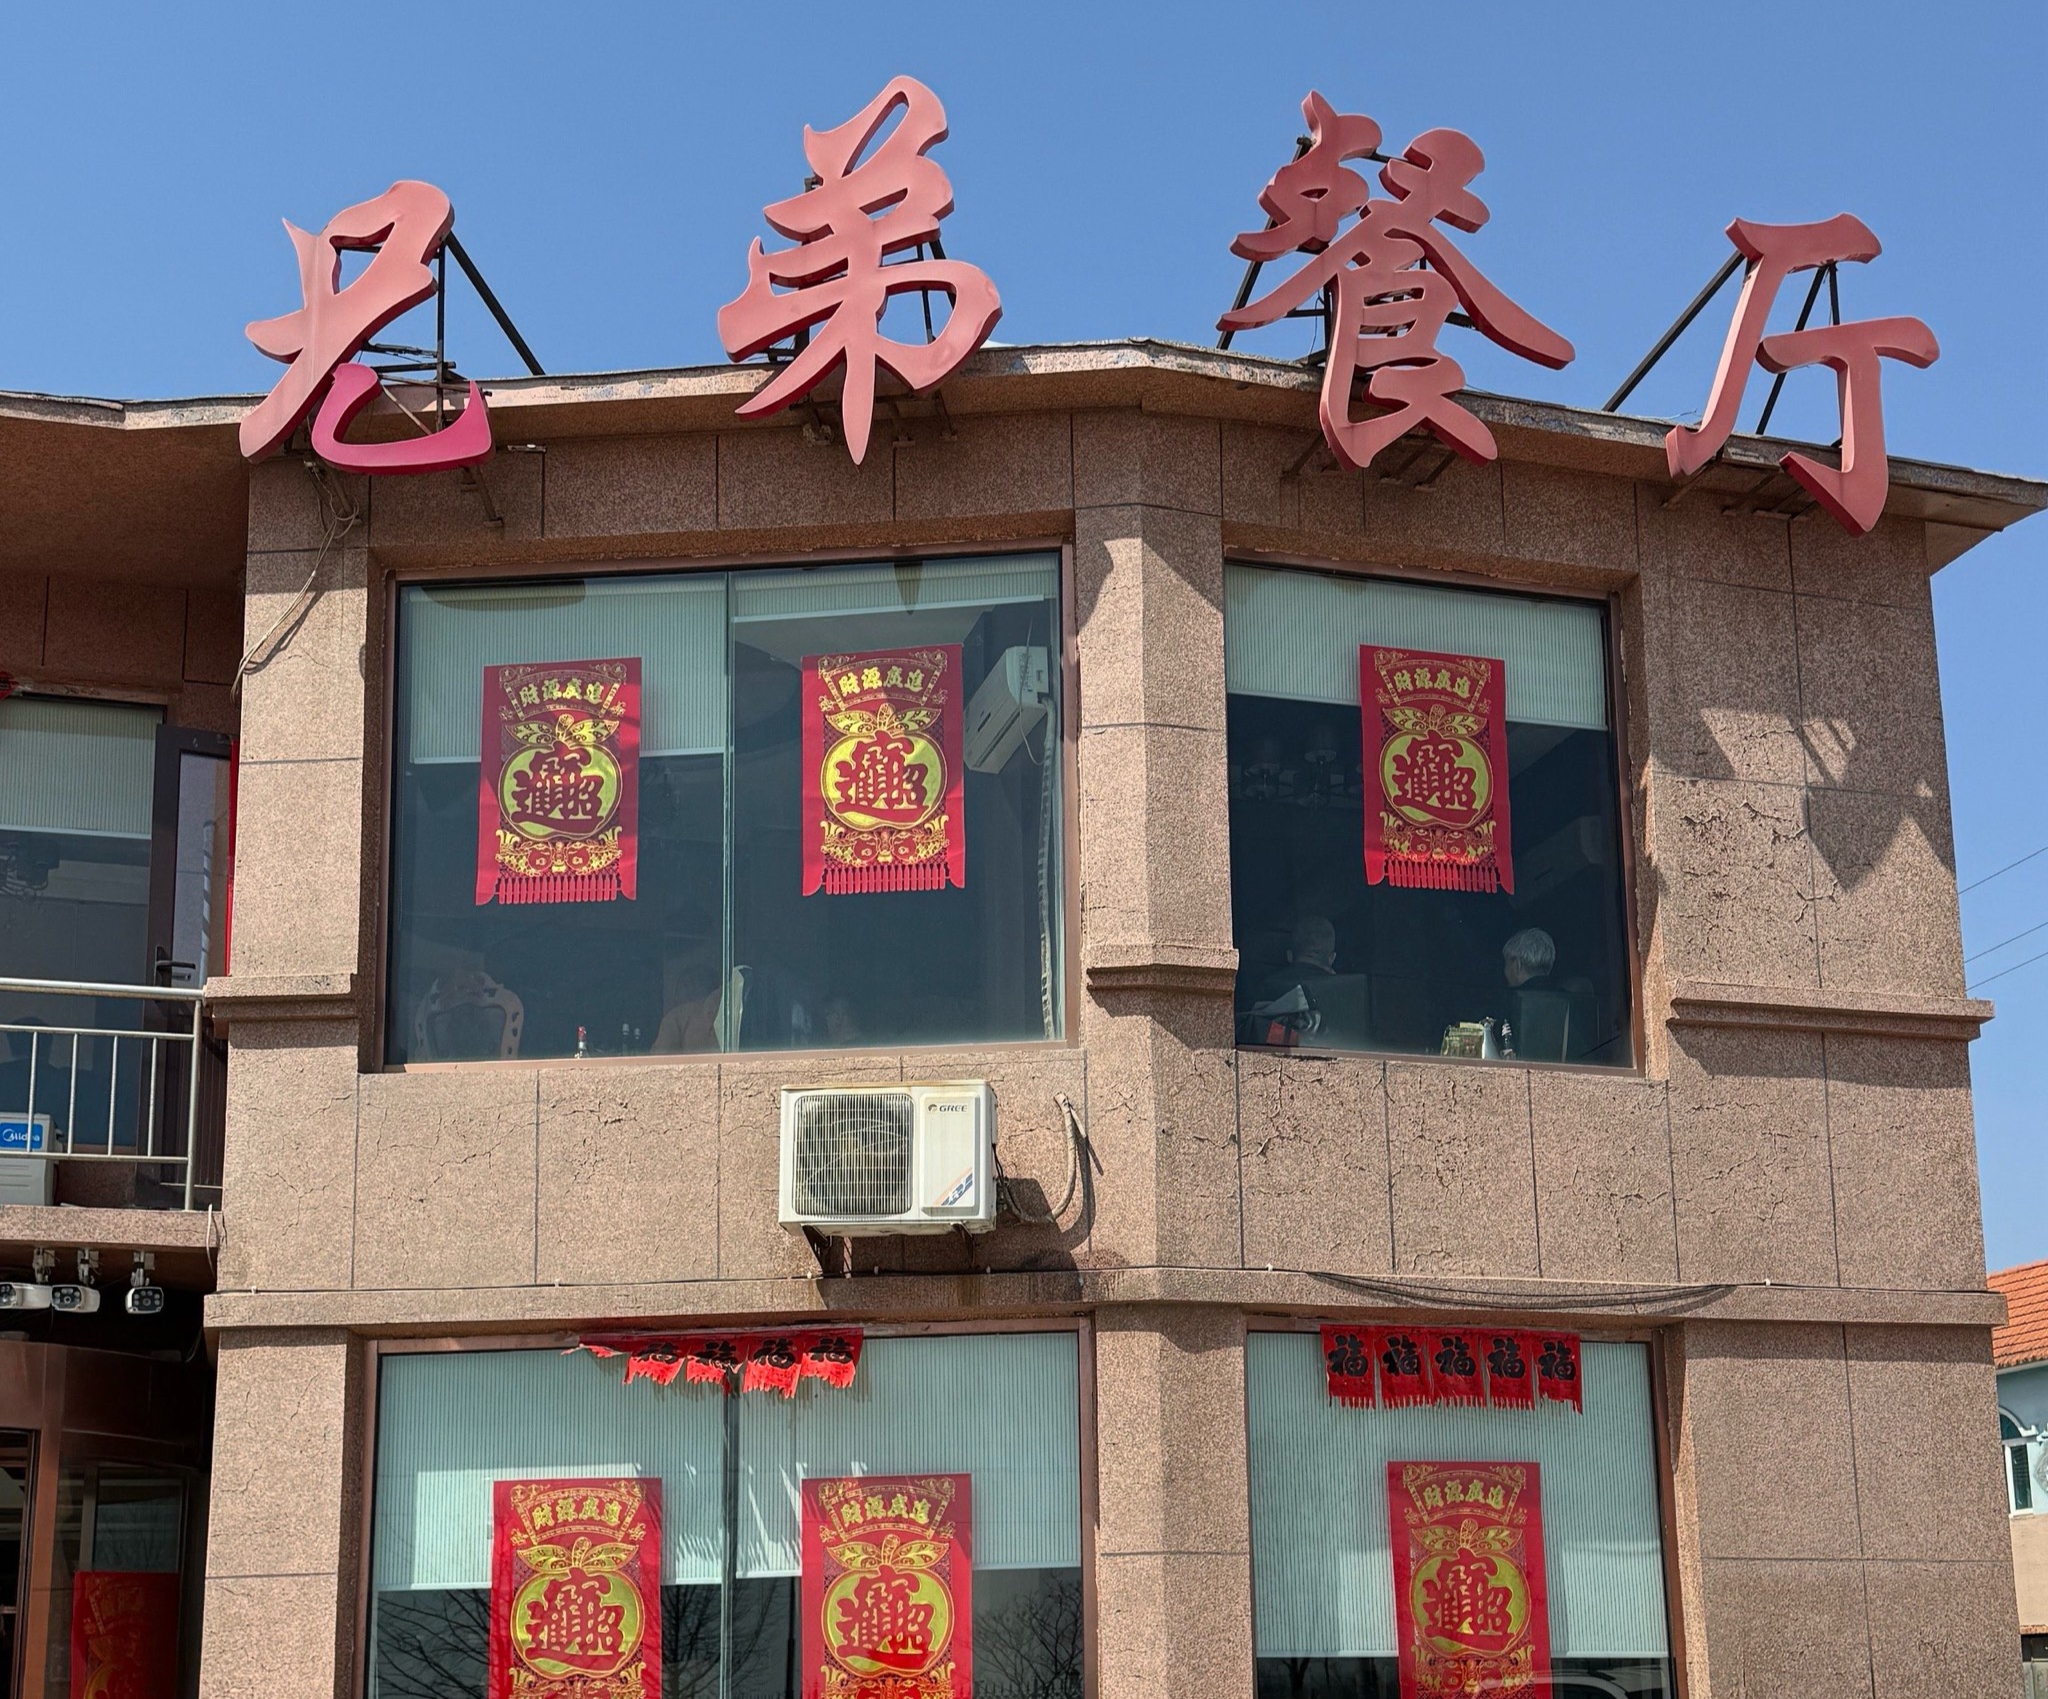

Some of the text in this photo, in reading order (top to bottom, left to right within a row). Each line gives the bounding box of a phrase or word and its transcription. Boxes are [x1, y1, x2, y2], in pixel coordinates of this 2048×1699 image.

[239, 75, 1940, 537] 兄弟餐厅
[938, 1103, 968, 1113] GREE
[6, 1130, 40, 1142] Mida
